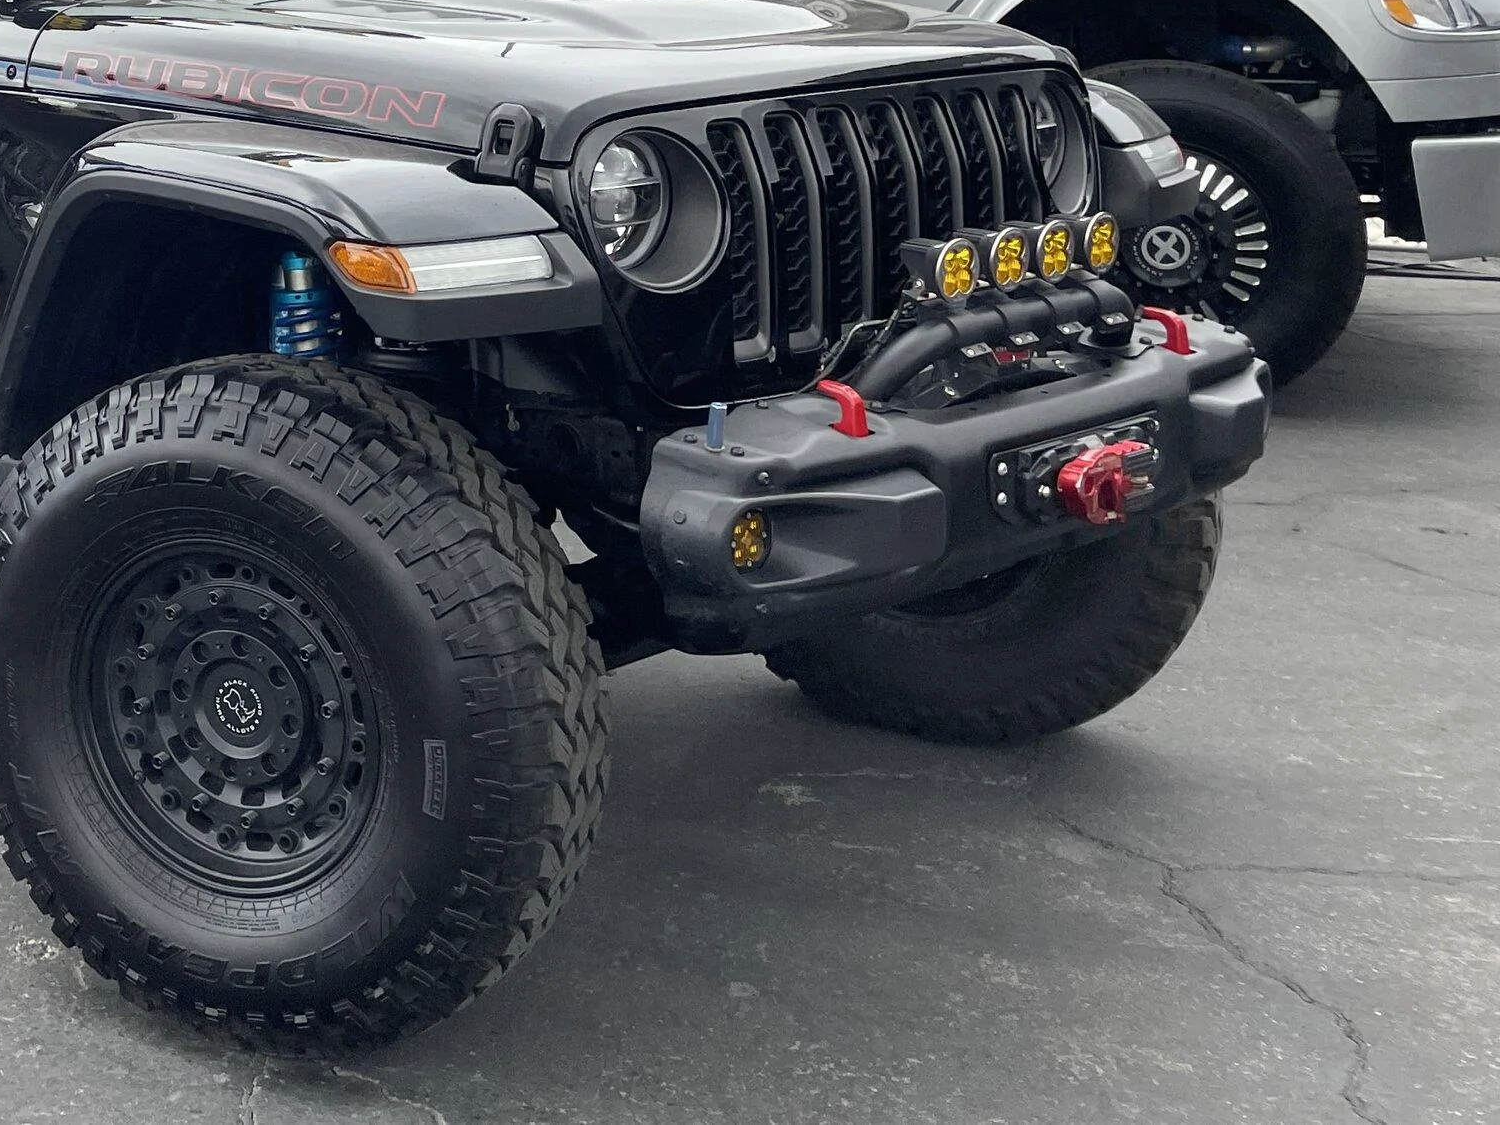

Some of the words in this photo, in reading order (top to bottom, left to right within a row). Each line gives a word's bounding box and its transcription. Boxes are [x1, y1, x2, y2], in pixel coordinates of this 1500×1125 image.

[61, 50, 446, 128] RUBICON
[223, 679, 248, 688] BLACK
[215, 696, 226, 722] HARD
[249, 688, 263, 716] RHINO
[226, 723, 256, 734] ALLOYS
